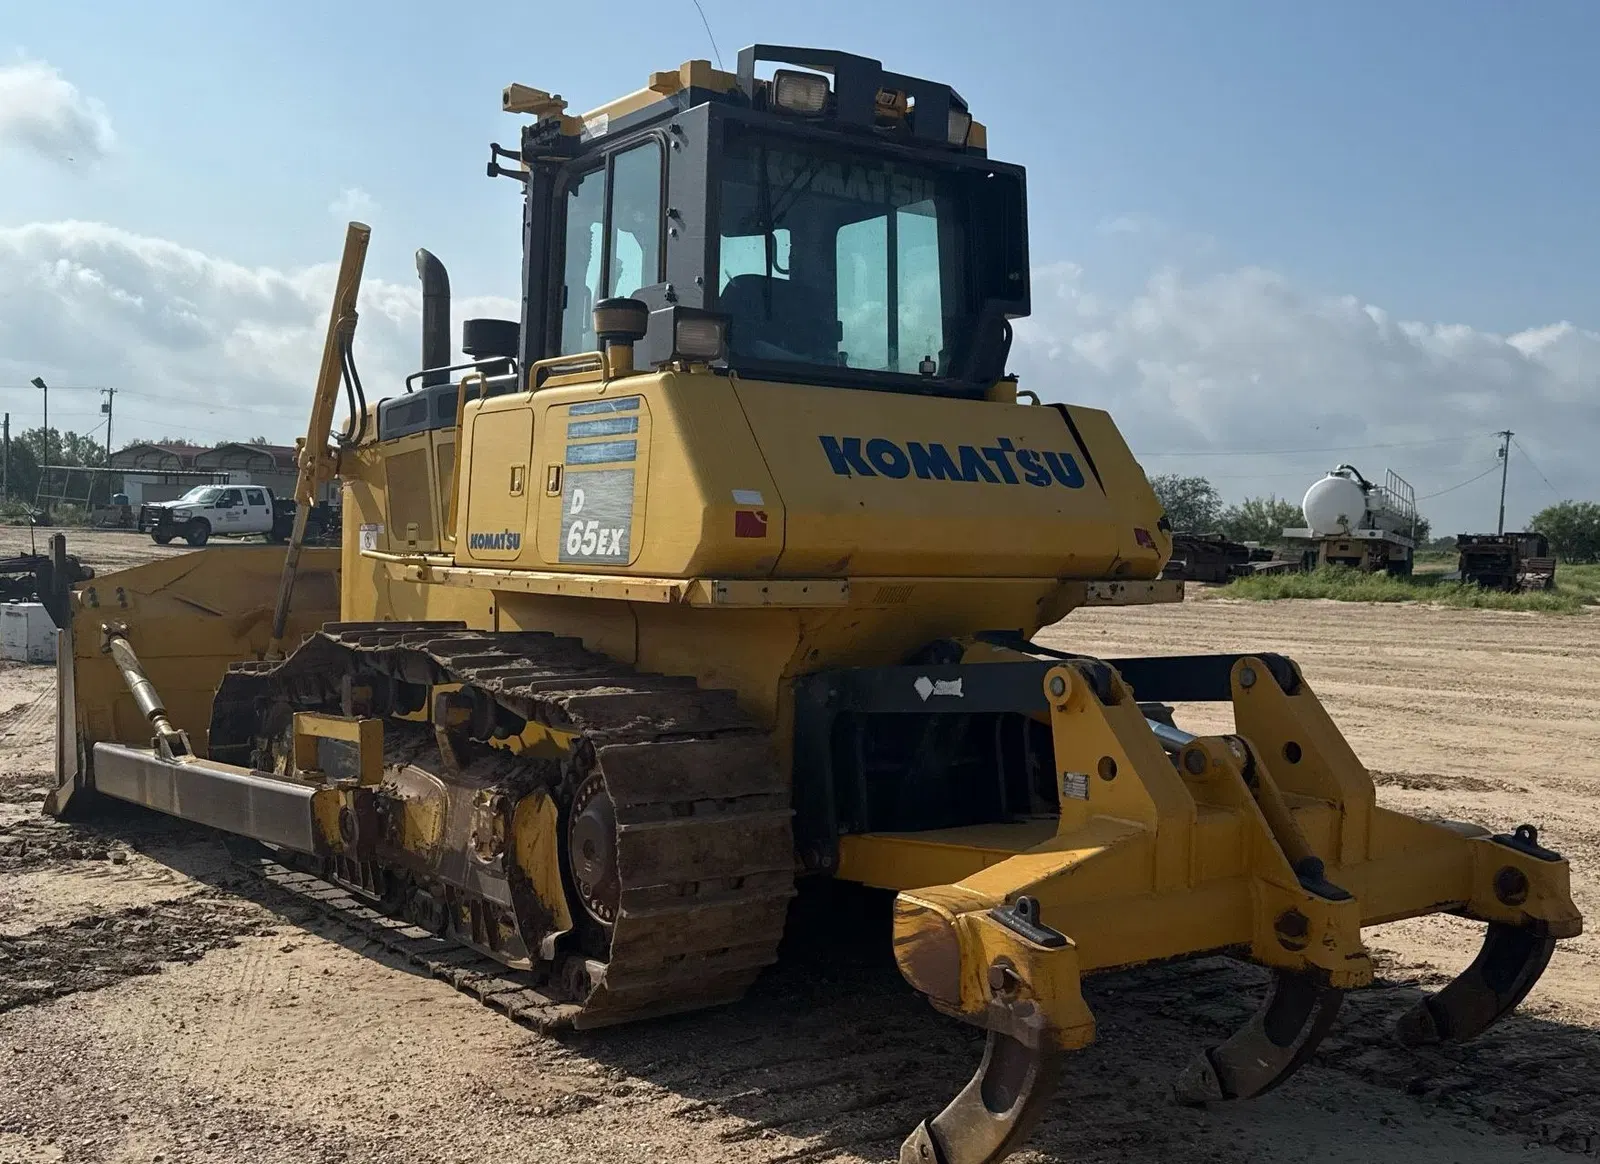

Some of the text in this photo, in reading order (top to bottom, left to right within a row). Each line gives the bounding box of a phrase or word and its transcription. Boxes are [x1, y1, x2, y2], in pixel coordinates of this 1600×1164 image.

[818, 436, 1085, 489] KOMATSU
[570, 489, 585, 515] D
[470, 528, 521, 550] KOMATSU
[566, 520, 624, 556] 65EX
